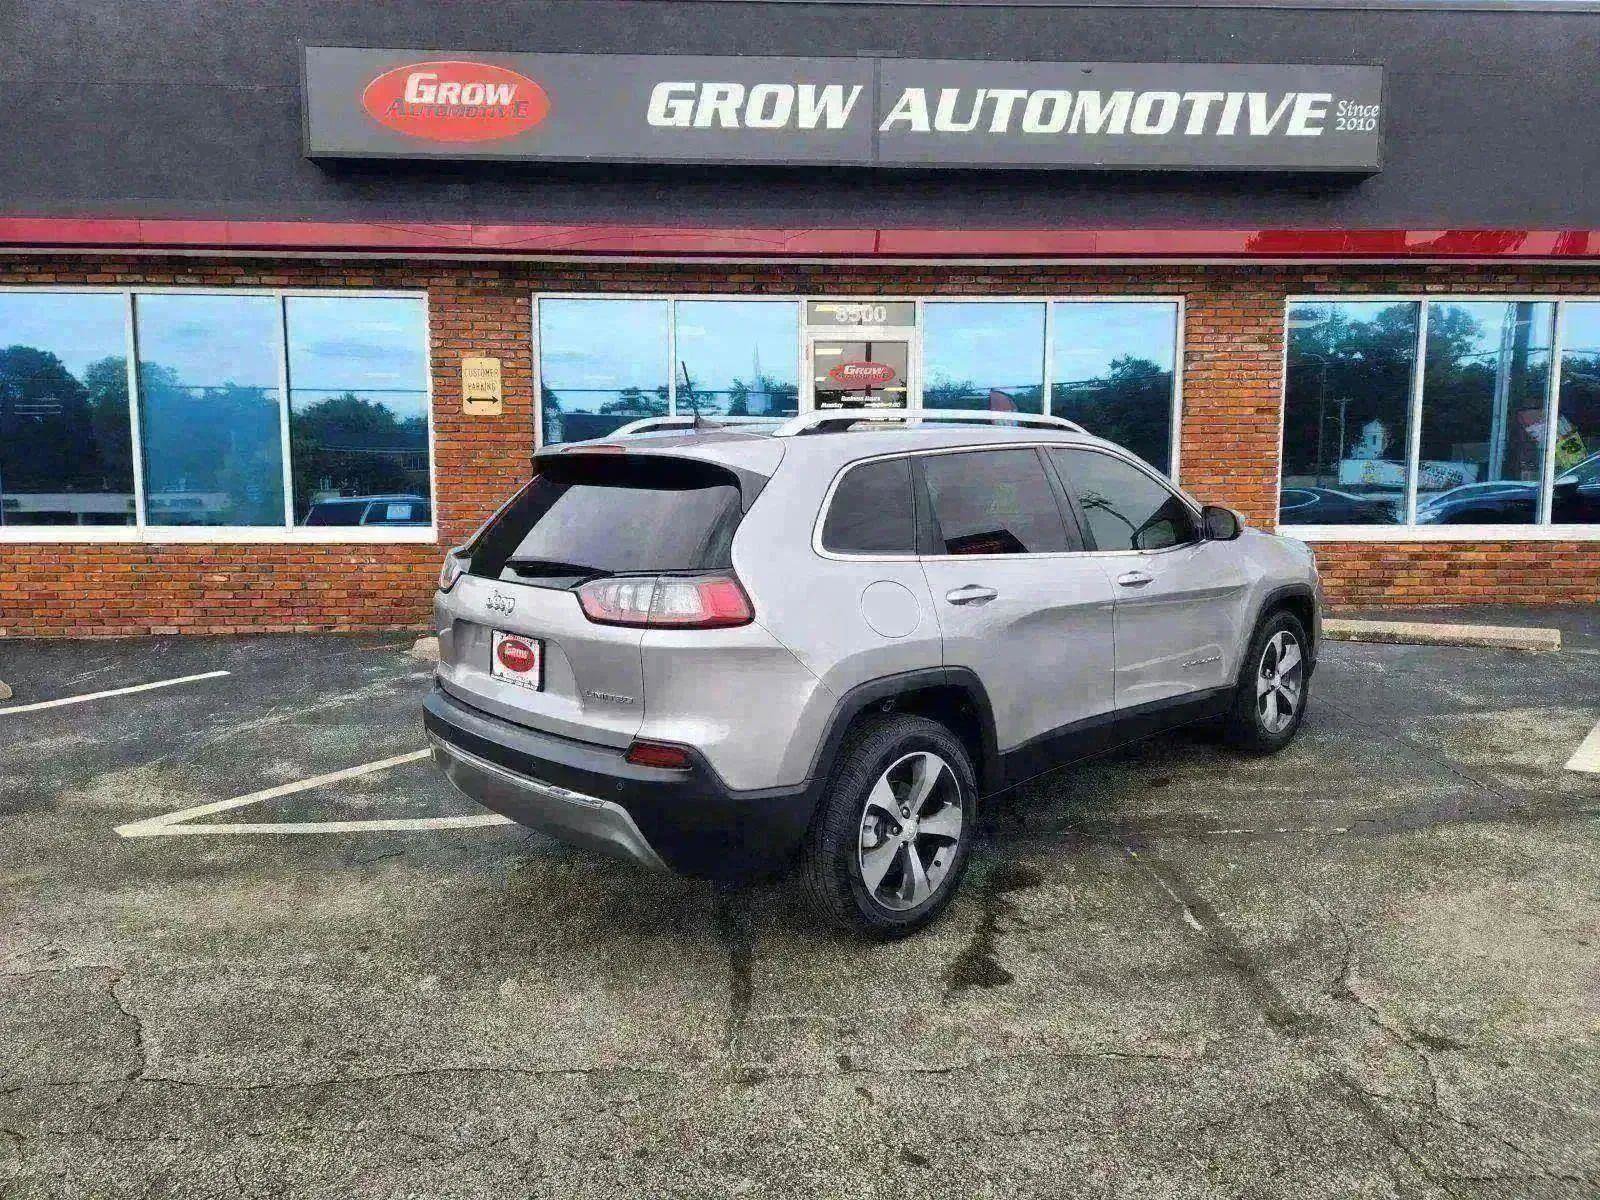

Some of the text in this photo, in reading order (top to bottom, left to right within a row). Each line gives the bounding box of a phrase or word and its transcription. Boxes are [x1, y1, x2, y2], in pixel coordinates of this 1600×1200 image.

[405, 73, 518, 105] GROW
[385, 97, 530, 119] AUTOMOTIVE
[647, 82, 1332, 136] GROW AUTOMOTIVE
[1335, 100, 1379, 117] Since
[1335, 117, 1376, 131] 2010
[467, 382, 496, 391] PARKING
